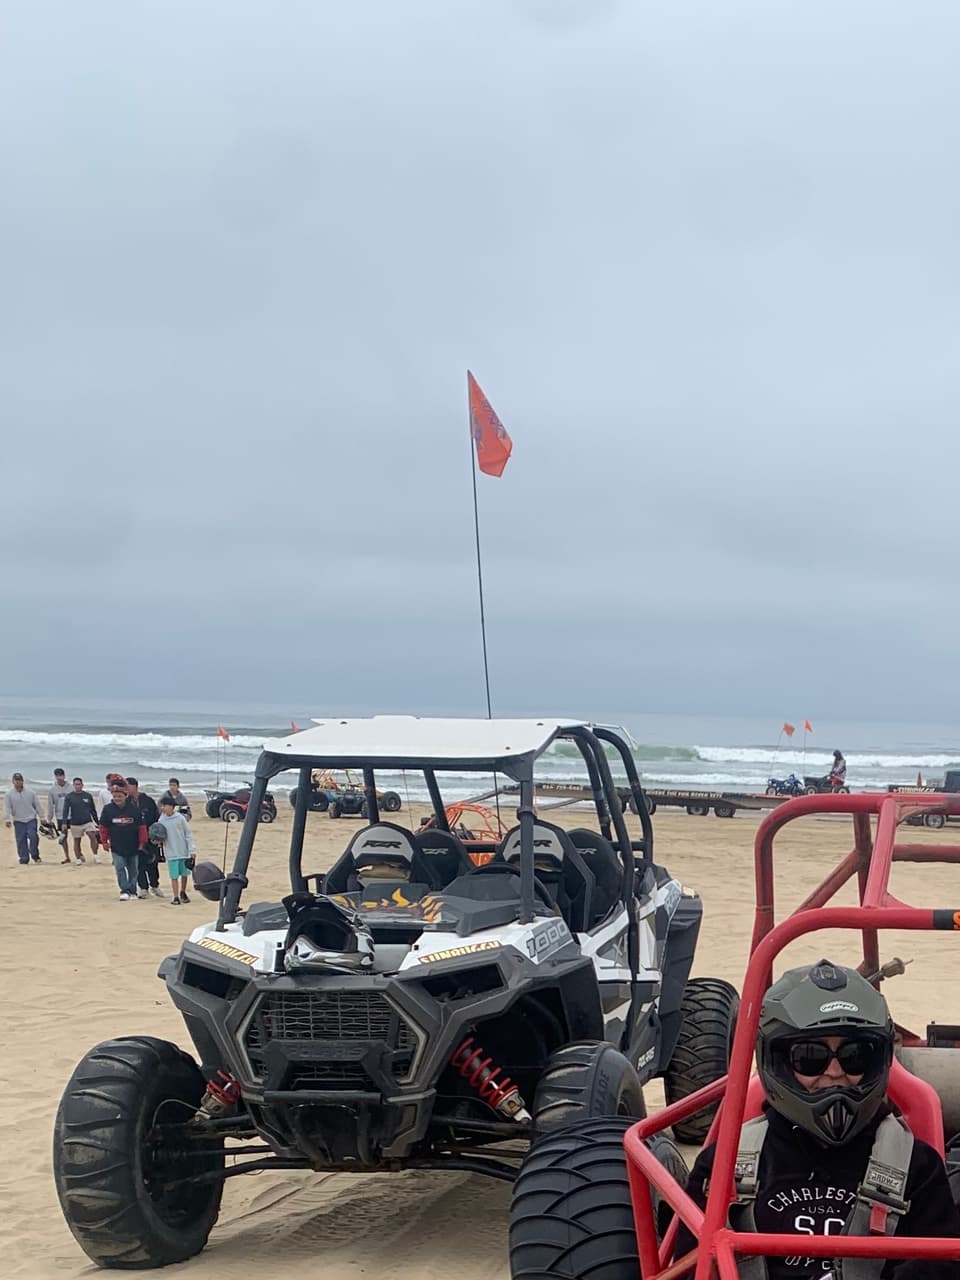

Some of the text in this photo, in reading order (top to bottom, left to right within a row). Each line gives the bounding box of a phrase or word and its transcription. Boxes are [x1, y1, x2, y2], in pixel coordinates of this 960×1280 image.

[526, 920, 568, 959] 1000
[767, 1187, 857, 1212] CHARLEST
[808, 1205, 835, 1214] USA
